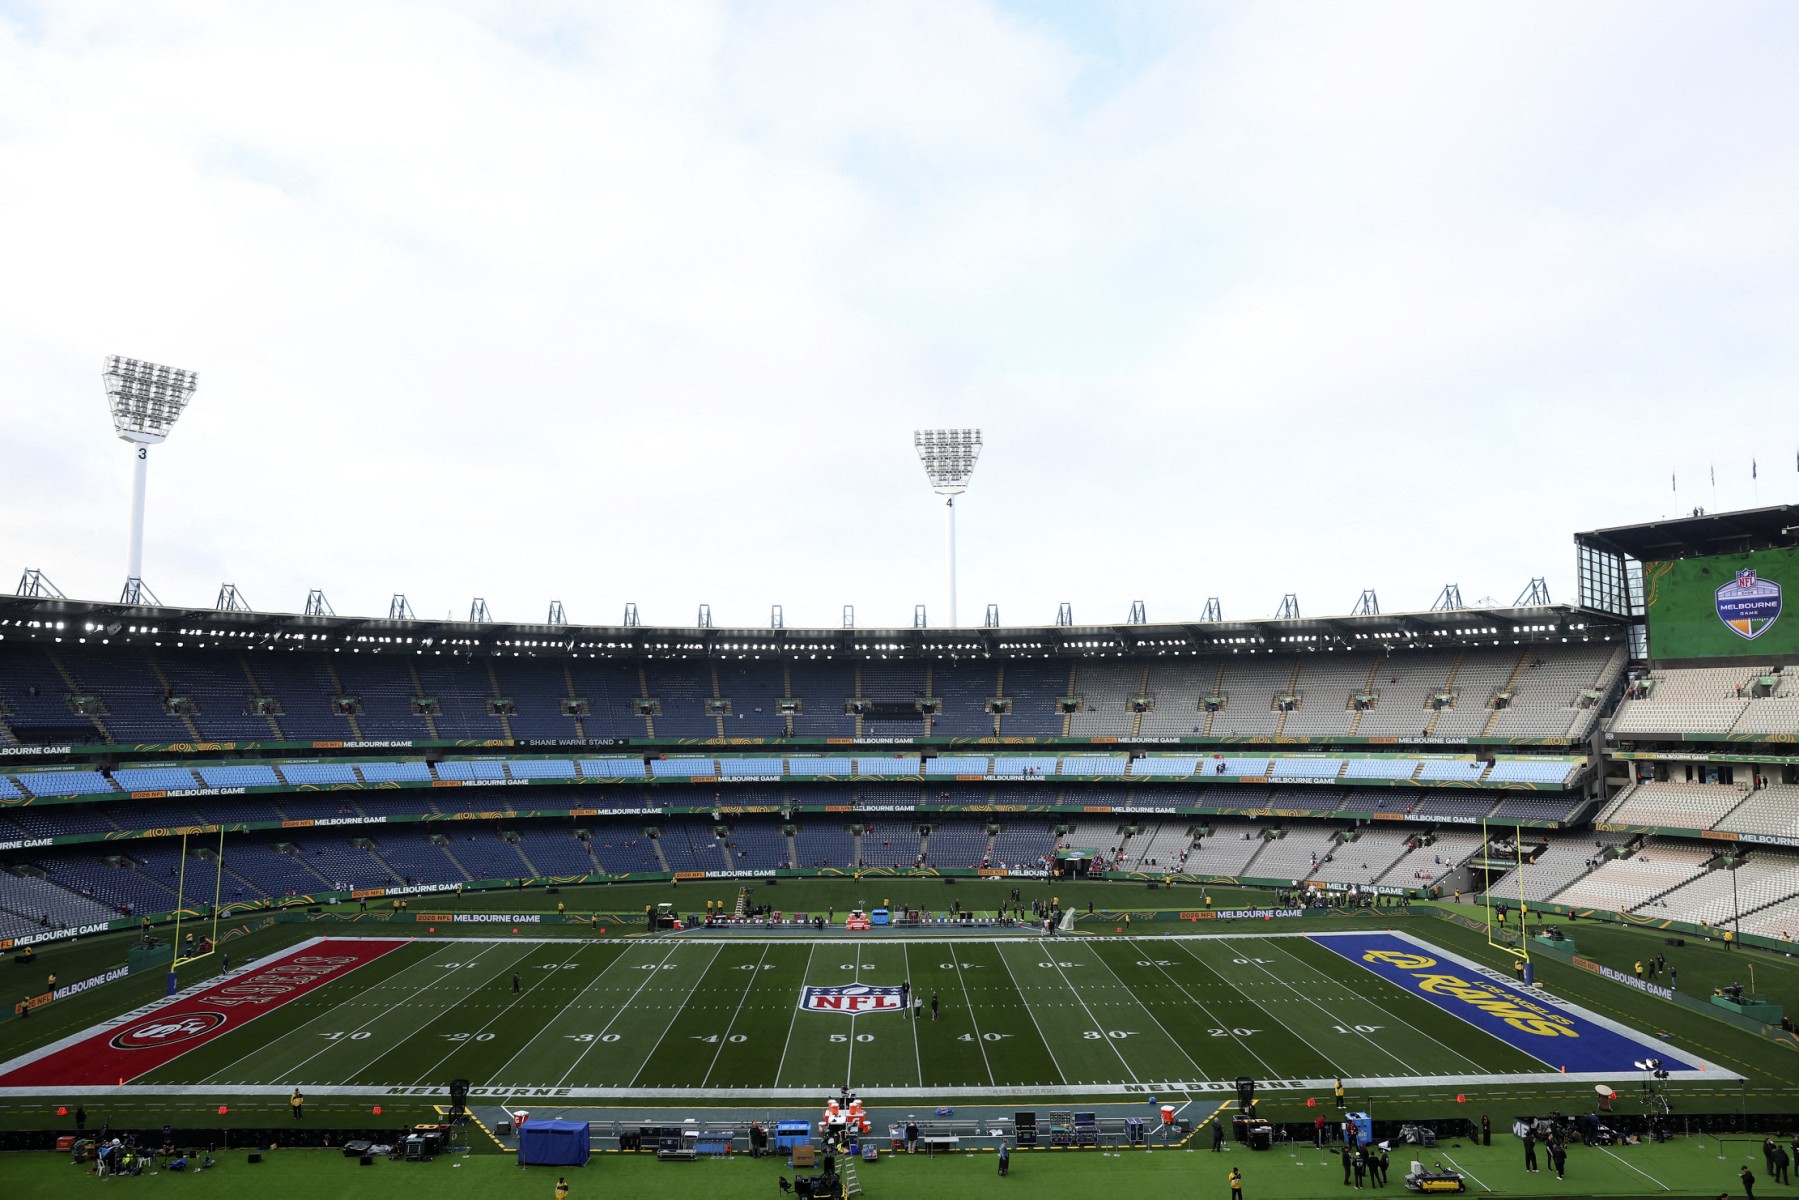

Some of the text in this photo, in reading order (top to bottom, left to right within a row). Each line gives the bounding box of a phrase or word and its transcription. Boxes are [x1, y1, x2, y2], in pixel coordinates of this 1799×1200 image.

[138, 448, 147, 459] 3
[946, 498, 952, 507] 4
[1738, 578, 1754, 586] NFL
[1720, 601, 1777, 610] MELBOURNE
[167, 788, 219, 797] MELBOURNE
[24, 838, 53, 847] GAME
[1739, 834, 1799, 846] MELBOURNE
[386, 884, 436, 895] MELBOURNE
[1218, 910, 1274, 918] MELBOURNE
[14, 927, 77, 946] MELBOURNE
[79, 922, 108, 934] GAME
[198, 956, 359, 1006] 49ERS
[1587, 961, 1599, 972] NFL
[1600, 966, 1646, 990] MELBOURNE
[1647, 981, 1672, 999] GAME
[38, 995, 50, 1004] NFL
[53, 975, 105, 1000] MELBOURNE
[106, 966, 128, 981] GAME
[813, 996, 897, 1010] NFL
[1412, 974, 1580, 1038] RAMS
[1472, 982, 1575, 1025] LOS ANGELES
[132, 1019, 208, 1039] SF
[1208, 1028, 1252, 1037] 20
[1333, 1025, 1375, 1033] 10
[325, 1031, 372, 1040] 10
[448, 1032, 496, 1041] 20
[574, 1034, 621, 1042] 30
[702, 1034, 748, 1043] 40
[830, 1034, 875, 1042] 50
[957, 1033, 1002, 1041] 40
[1084, 1031, 1128, 1039] 30
[386, 1087, 572, 1096] MELOURNE
